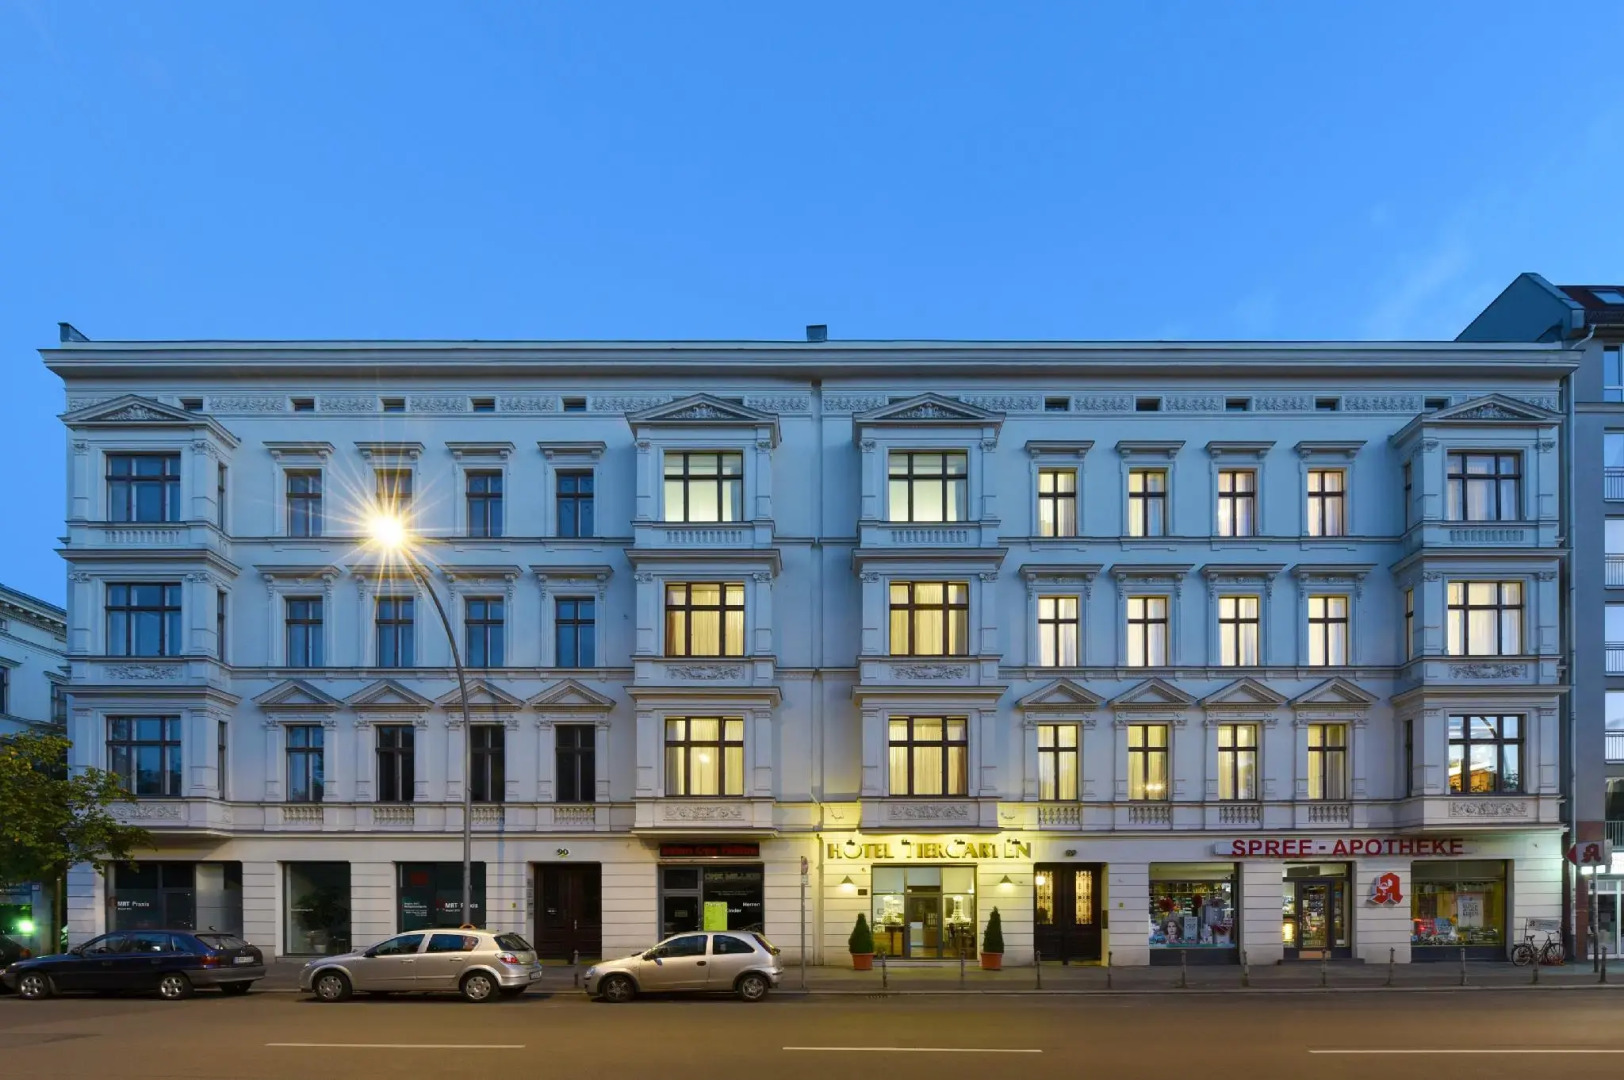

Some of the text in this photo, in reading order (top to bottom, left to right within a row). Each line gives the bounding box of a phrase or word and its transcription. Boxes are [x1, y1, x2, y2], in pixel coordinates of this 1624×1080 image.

[827, 843, 895, 859] HOTEL
[1231, 839, 1313, 858] SPREE
[1332, 838, 1464, 857] APOTHEKE
